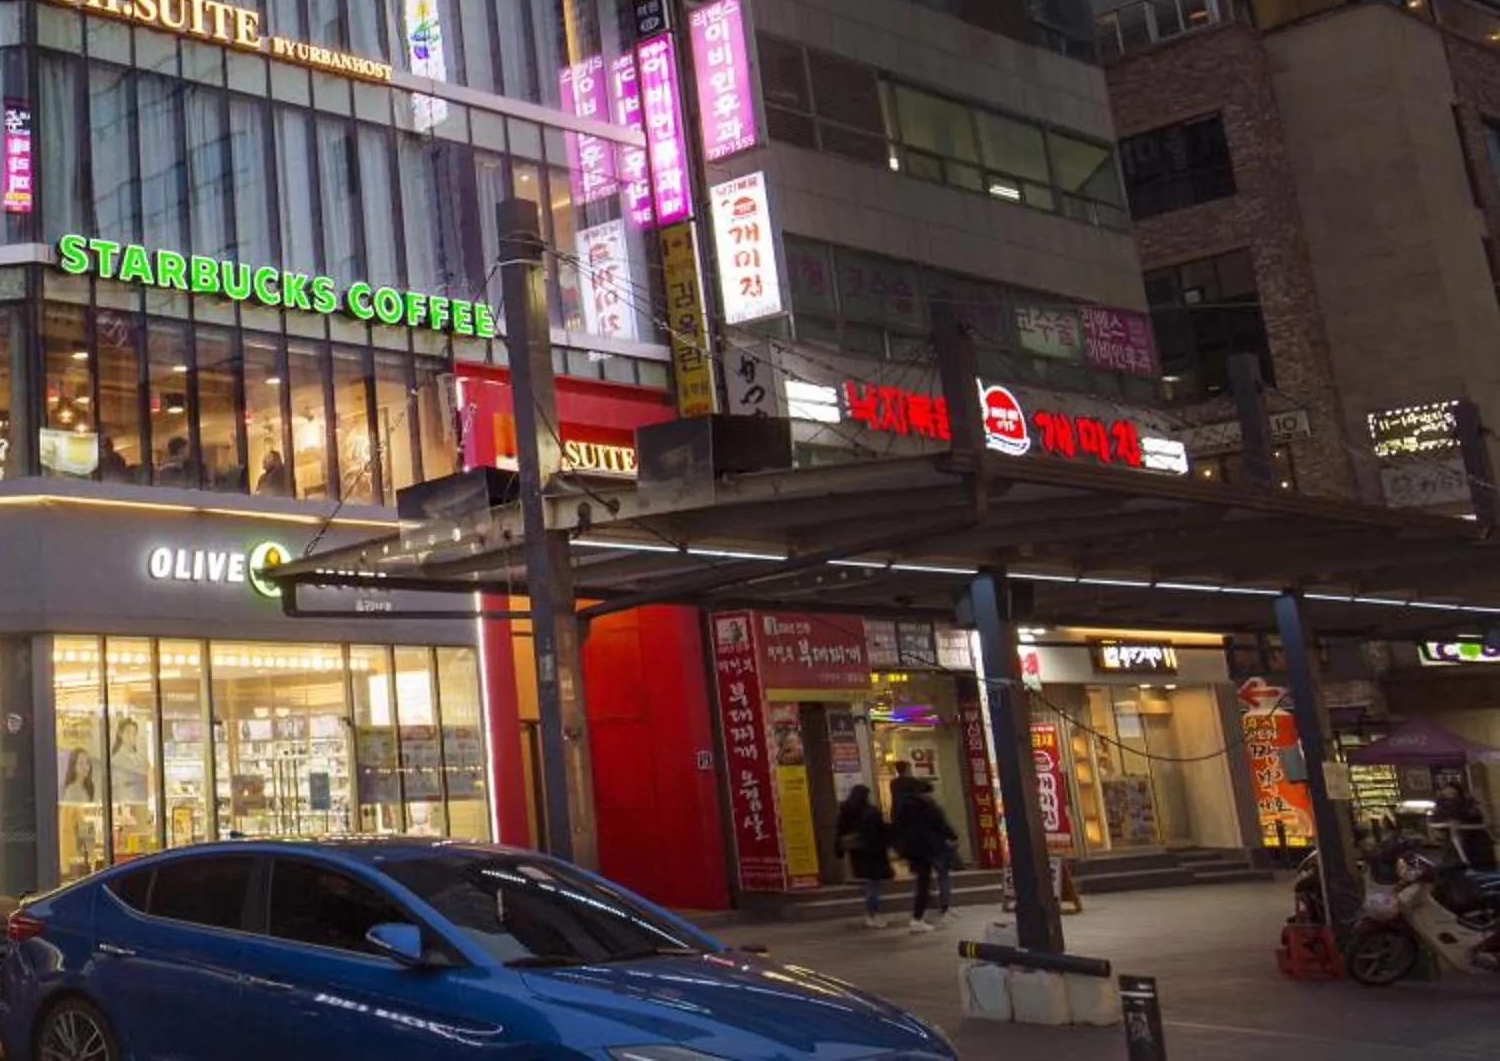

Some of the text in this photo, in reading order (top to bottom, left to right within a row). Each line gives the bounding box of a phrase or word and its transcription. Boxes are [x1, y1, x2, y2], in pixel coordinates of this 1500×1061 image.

[273, 36, 295, 57] BY
[703, 18, 744, 144] 이비인후과
[57, 233, 496, 340] STARBUCKS COFFEE
[727, 221, 764, 298] 개미집
[1032, 409, 1141, 469] 개미집
[149, 547, 246, 584] OLIVE
[911, 747, 935, 776] 약
